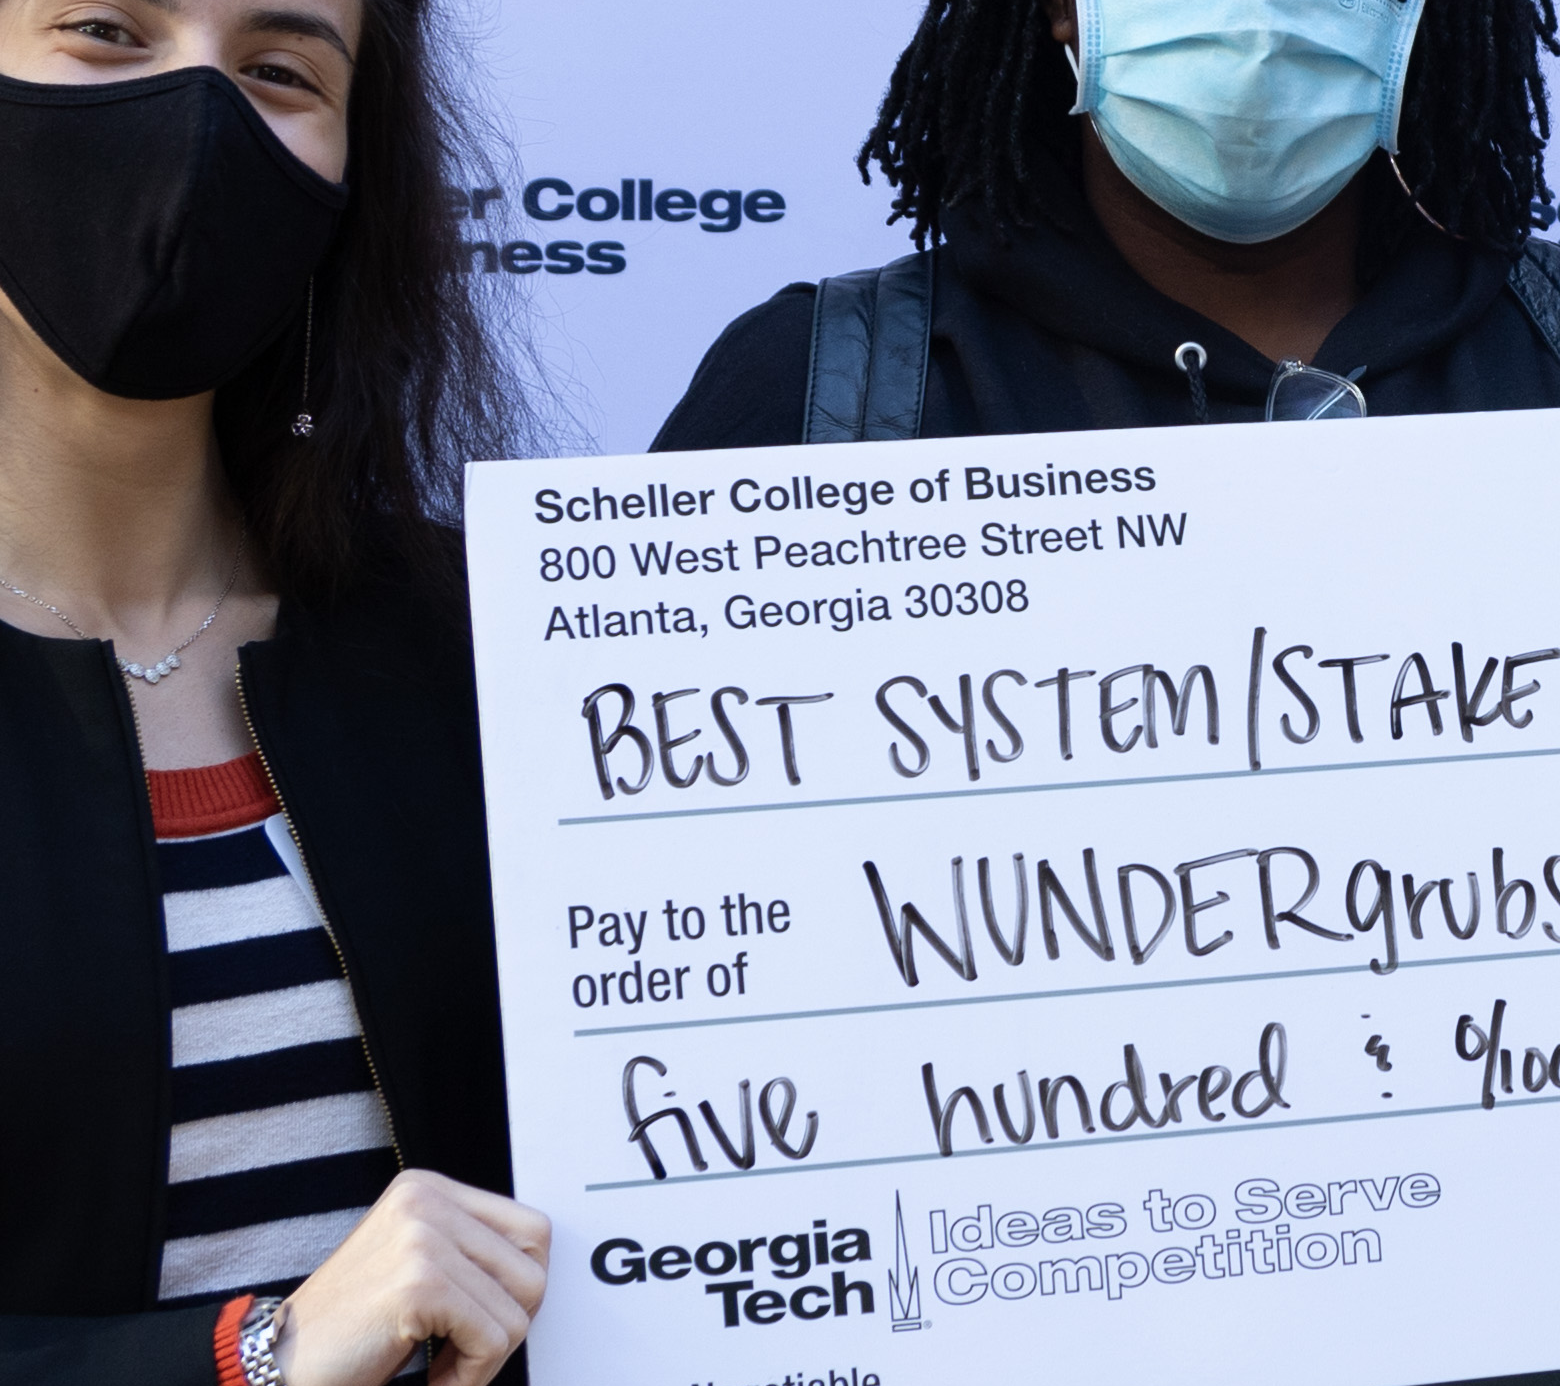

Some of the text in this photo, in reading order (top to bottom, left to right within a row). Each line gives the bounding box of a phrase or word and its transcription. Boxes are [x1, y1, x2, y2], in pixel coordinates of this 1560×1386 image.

[523, 179, 785, 232] College
[536, 464, 1155, 523] Scheller College of Business
[541, 513, 1186, 582] 800 West Peachtree Street NW
[545, 580, 1028, 640] Atlanta, Georgia 30308
[580, 683, 834, 801] BEST
[569, 893, 792, 954] Pay to the
[574, 952, 748, 1007] order of
[620, 1053, 820, 1179] five
[920, 1023, 1292, 1157] hundred
[928, 1167, 1442, 1257] Ideas to Serve
[591, 1220, 871, 1284] Georgia
[931, 1221, 1384, 1307] Competition
[706, 1271, 874, 1327] Tech
